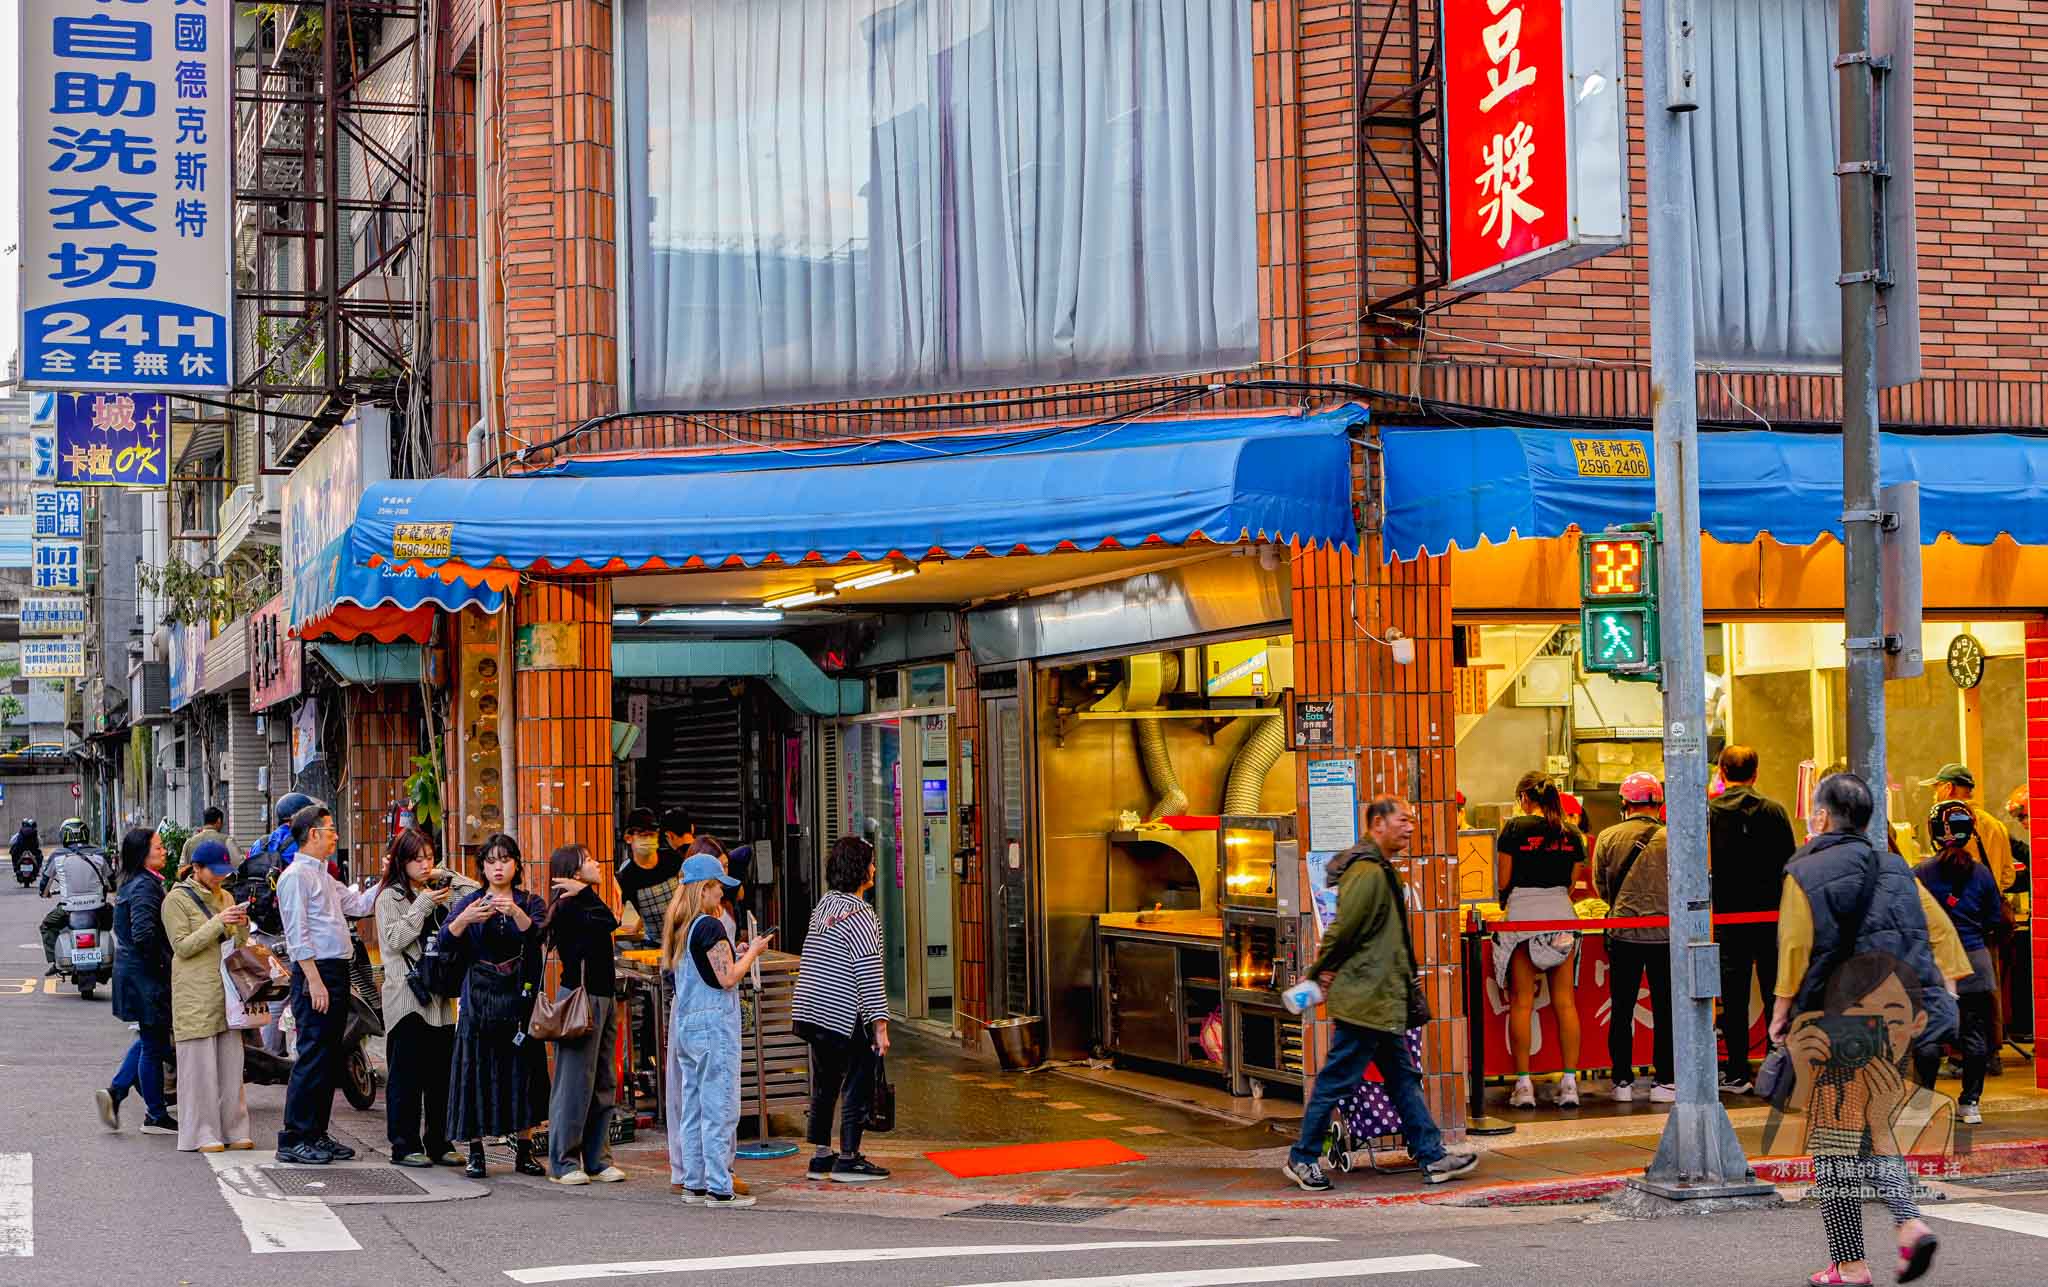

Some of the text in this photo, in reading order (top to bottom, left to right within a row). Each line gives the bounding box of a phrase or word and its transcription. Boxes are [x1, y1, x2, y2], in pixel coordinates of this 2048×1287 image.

[174, 0, 208, 239] 國德克斯特
[48, 0, 157, 290] 自助洗衣坊
[41, 312, 214, 347] 24H
[41, 349, 214, 376] 全年無休
[92, 392, 136, 431] 城
[63, 444, 160, 475] 卡拉OK
[1596, 544, 1637, 593] 32
[1305, 704, 1325, 713] Uber
